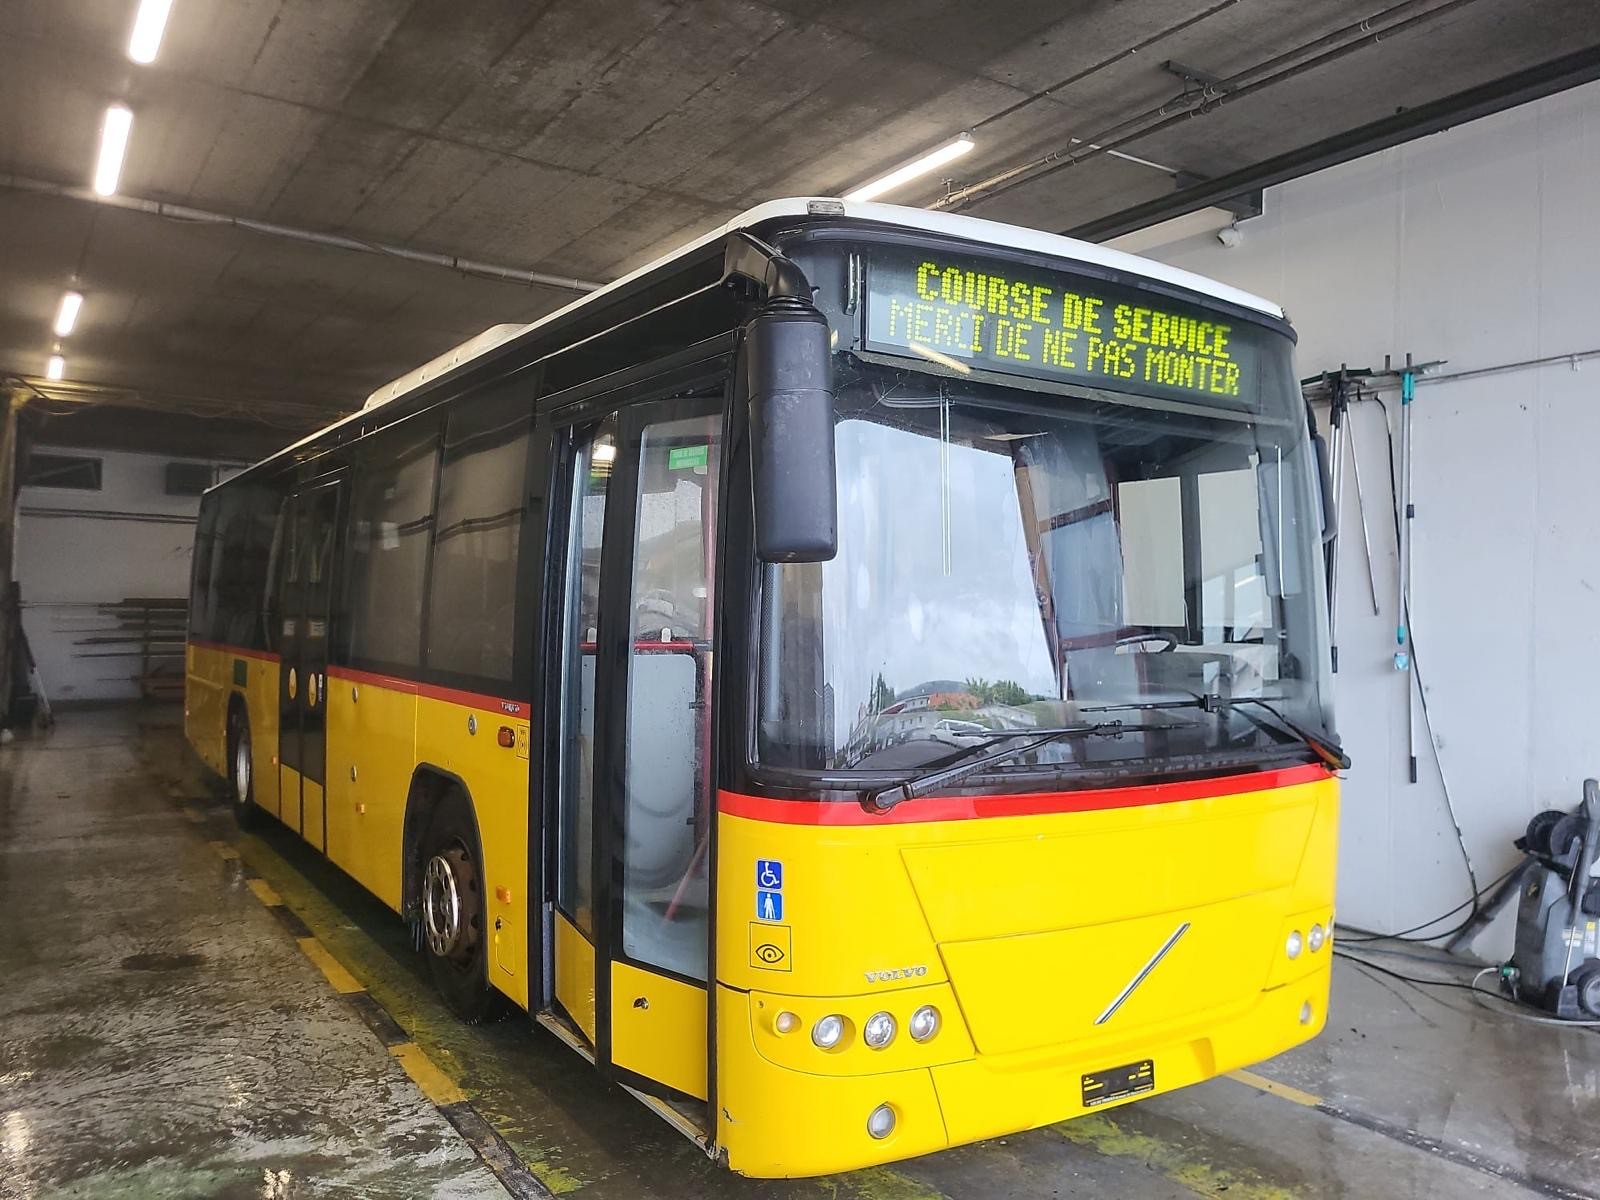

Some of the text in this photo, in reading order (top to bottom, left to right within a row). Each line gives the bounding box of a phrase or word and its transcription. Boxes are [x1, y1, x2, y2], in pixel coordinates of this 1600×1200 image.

[889, 299, 1240, 396] MERCI DE NE PAS MONTER
[917, 262, 1231, 359] COURSE DE SERVICE
[865, 965, 927, 983] VOLVO
